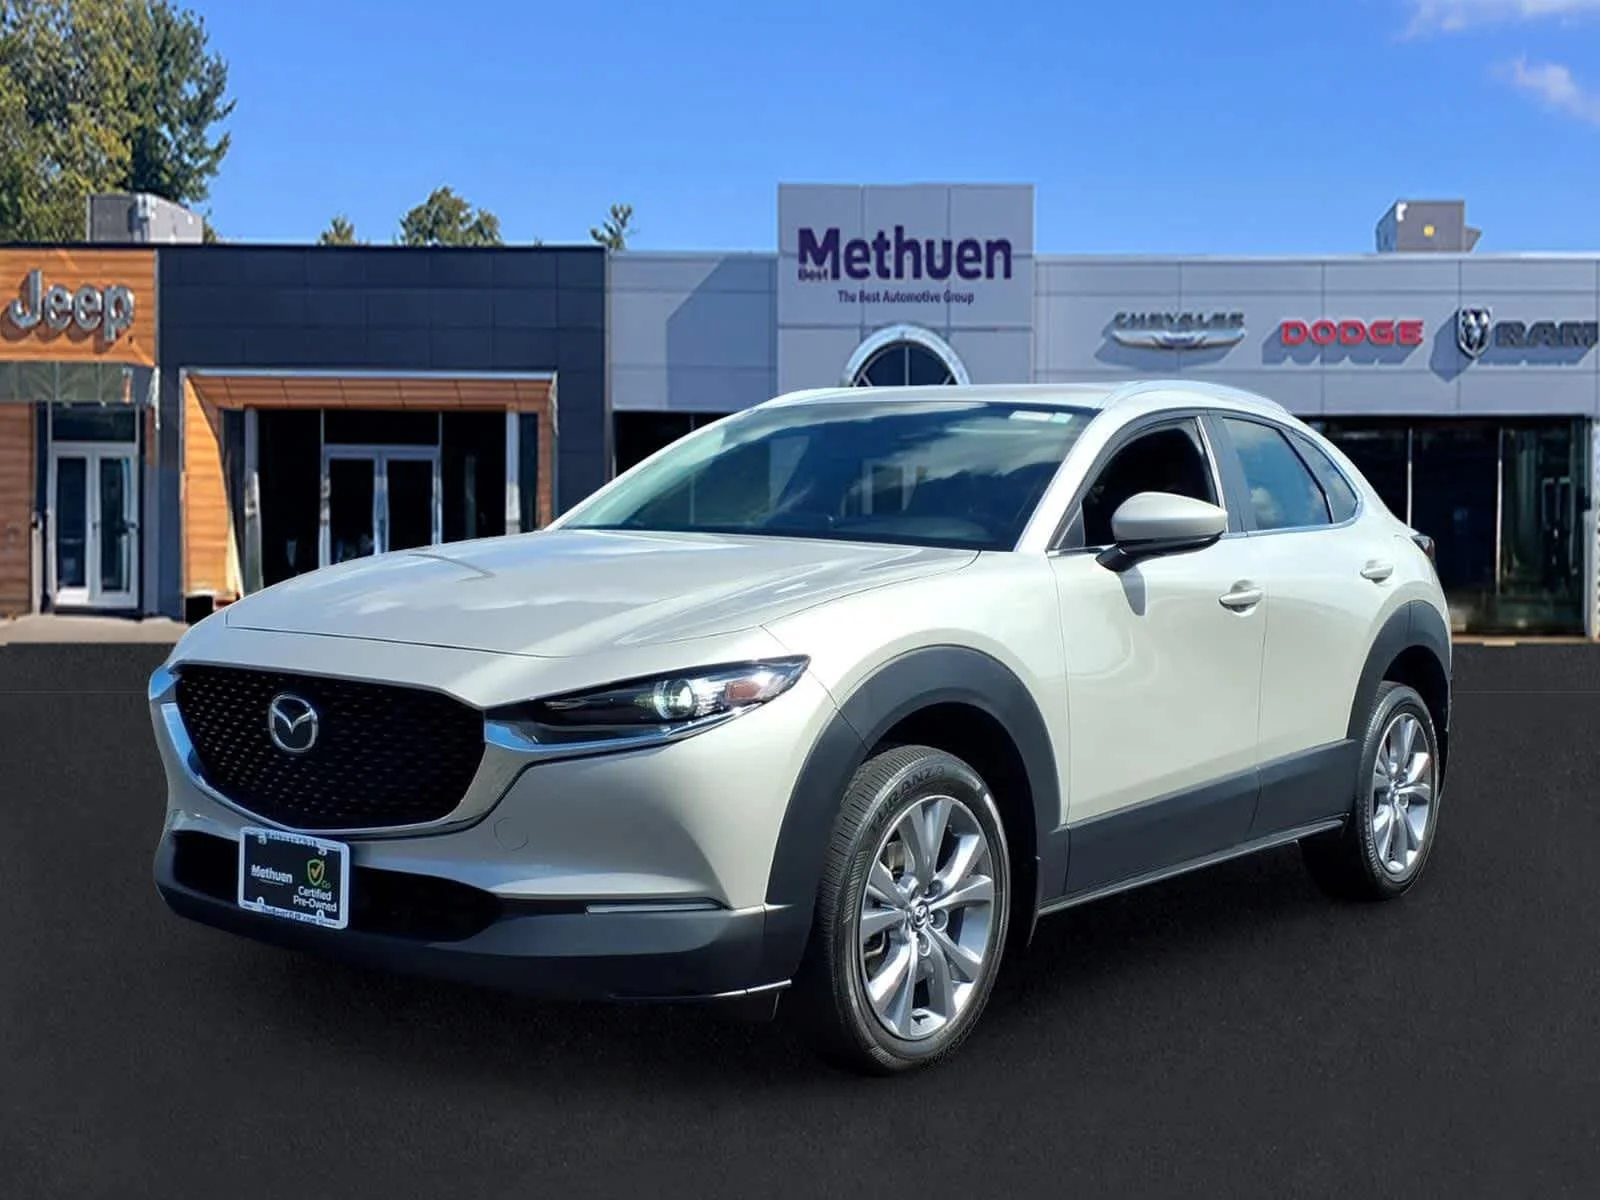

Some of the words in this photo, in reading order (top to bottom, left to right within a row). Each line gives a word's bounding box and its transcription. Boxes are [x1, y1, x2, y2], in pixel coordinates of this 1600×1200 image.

[798, 225, 1012, 280] Methuen
[8, 268, 135, 342] Jeep
[837, 290, 857, 303] The
[859, 290, 881, 304] Best
[883, 290, 941, 304] Automotive
[943, 289, 974, 305] Group
[1281, 319, 1424, 346] DODGE
[1494, 321, 1599, 348] RAM
[250, 863, 293, 884] Methuen
[293, 895, 338, 912] Pre-Owned
[298, 886, 332, 901] Certified
